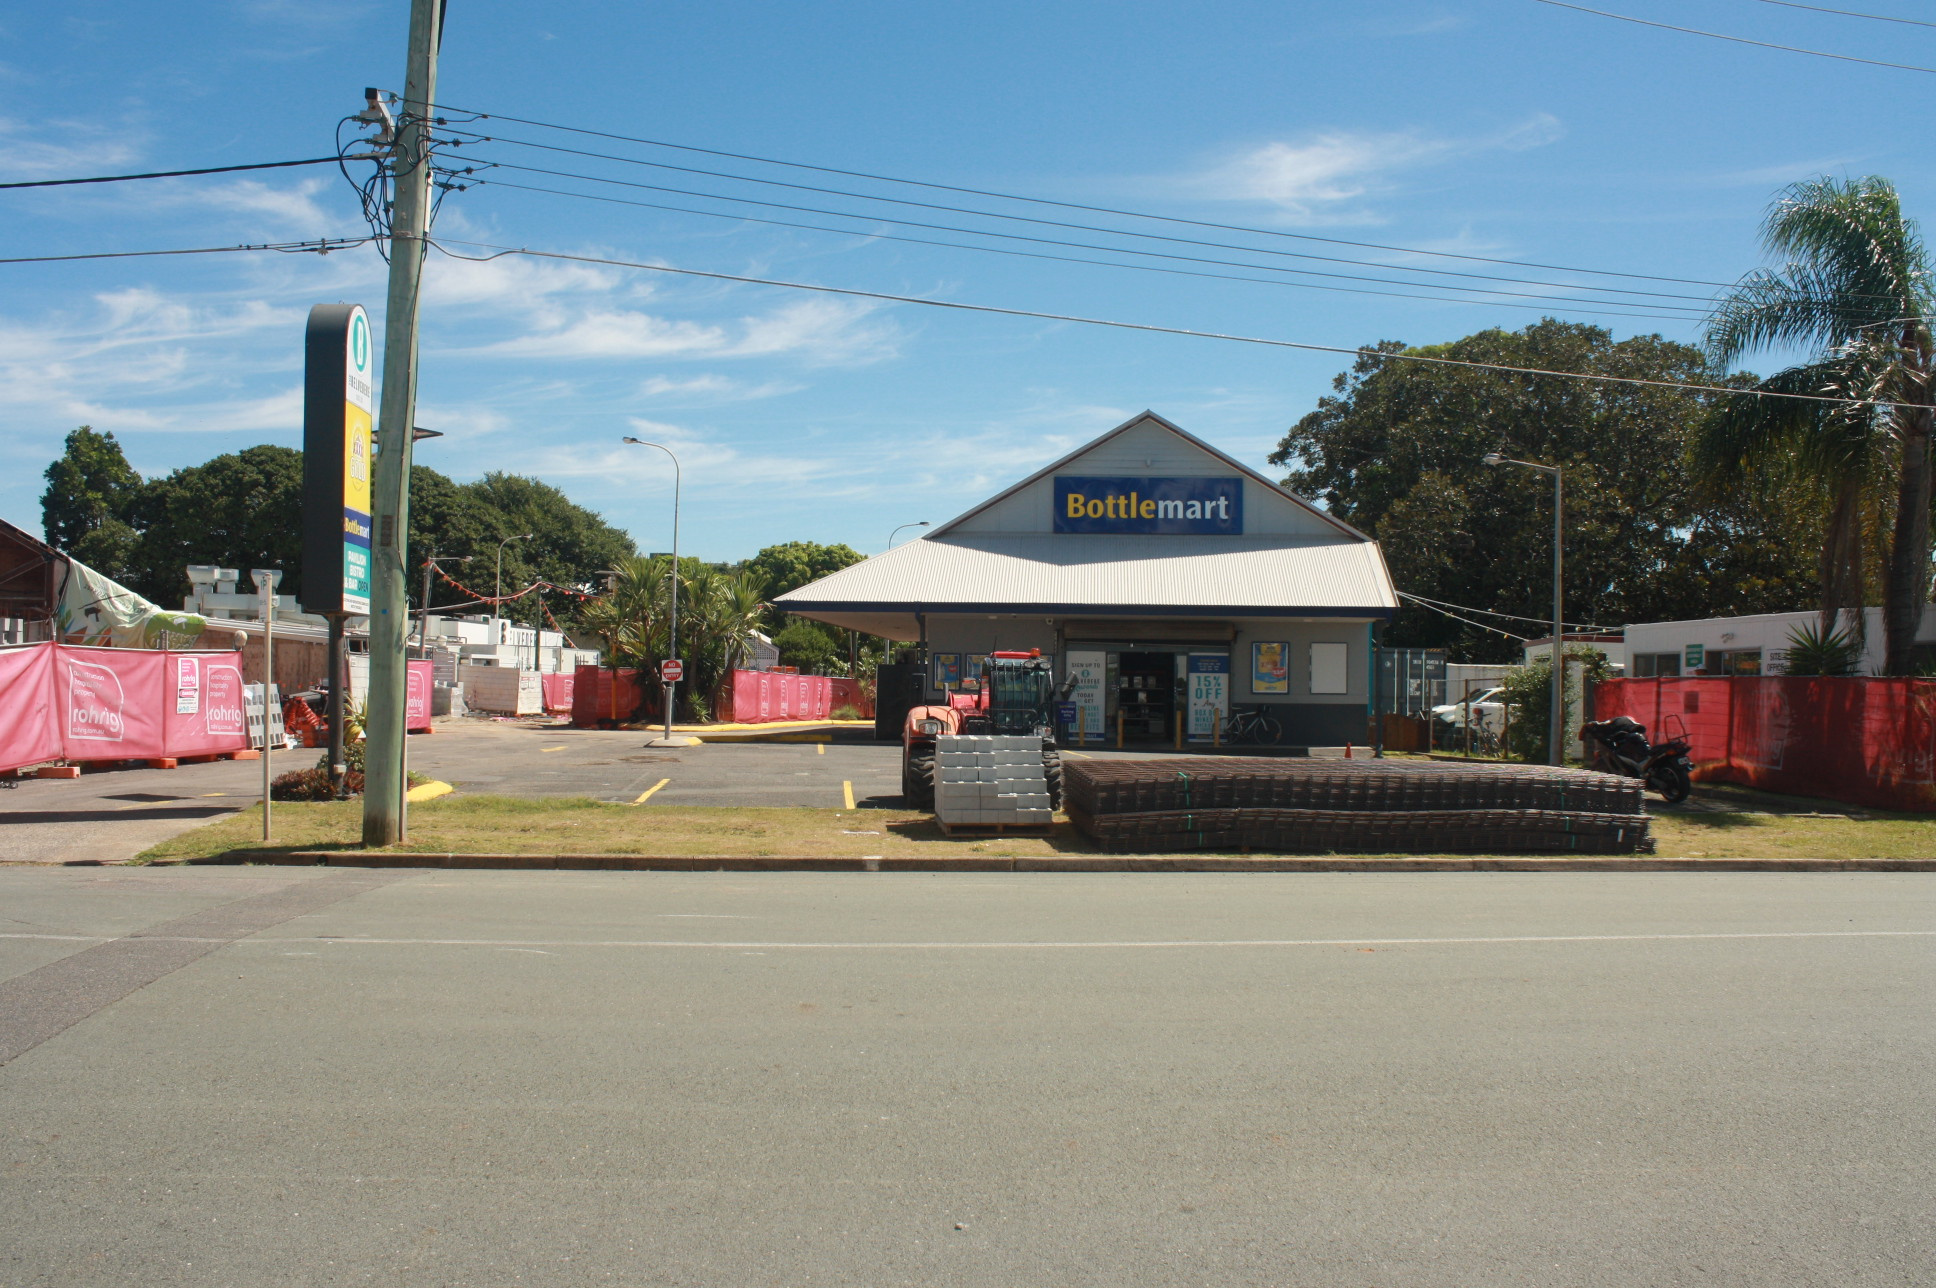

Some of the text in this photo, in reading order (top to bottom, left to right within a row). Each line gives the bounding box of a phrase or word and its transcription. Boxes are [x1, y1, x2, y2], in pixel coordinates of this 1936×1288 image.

[1067, 491, 1229, 520] Bottlemart
[344, 517, 370, 540] Bottlemart
[358, 580, 369, 593] OPEN
[1195, 675, 1221, 688] 15%
[1195, 687, 1222, 700] OFF
[73, 705, 120, 733] rohrig
[209, 704, 242, 727] rohrig
